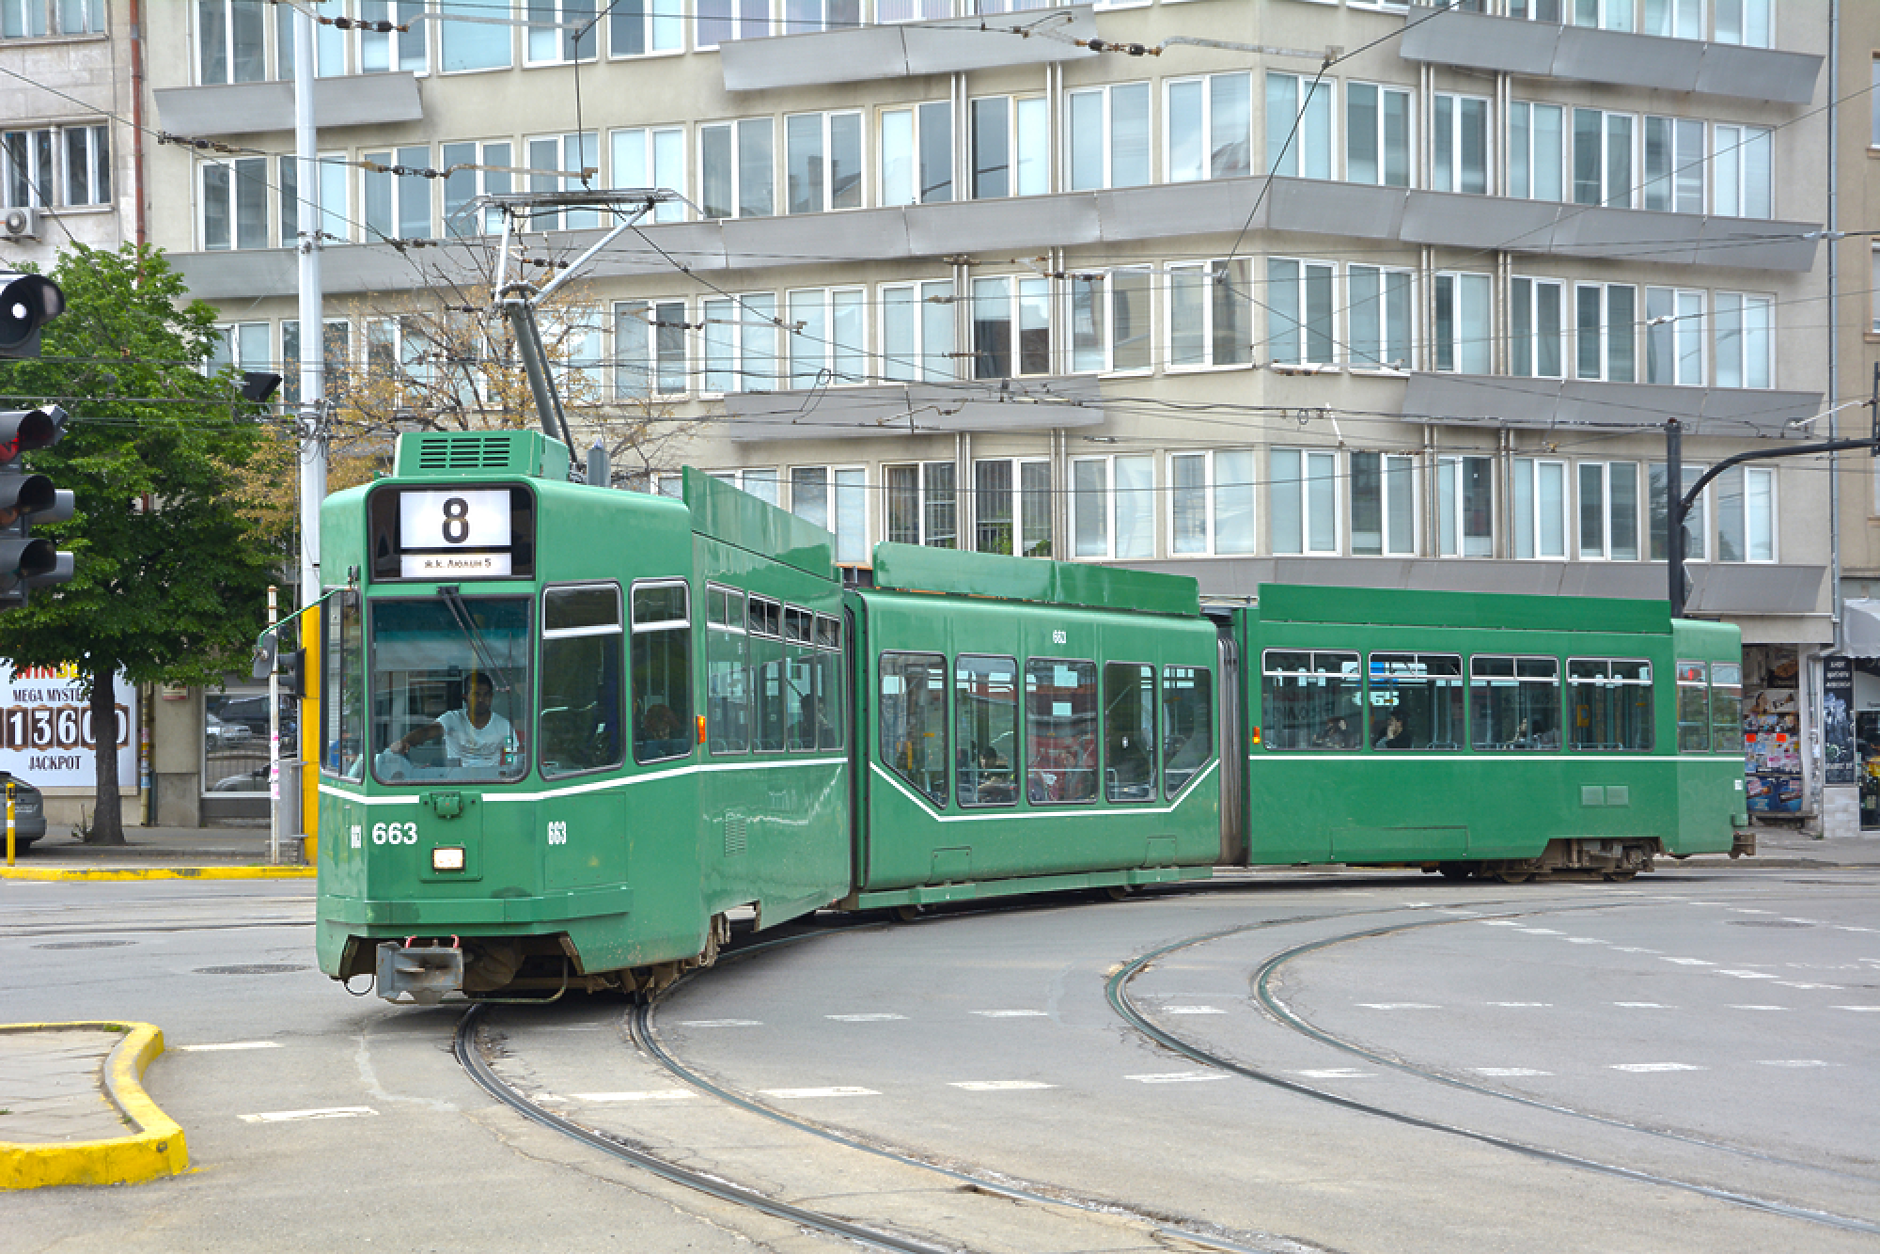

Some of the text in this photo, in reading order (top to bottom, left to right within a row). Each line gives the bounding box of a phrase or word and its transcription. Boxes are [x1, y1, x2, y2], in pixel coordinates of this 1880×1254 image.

[442, 497, 469, 544] 8
[12, 688, 43, 702] MEGA
[28, 755, 81, 771] JACKPOT
[372, 822, 418, 845] 663
[547, 821, 567, 845] 663
